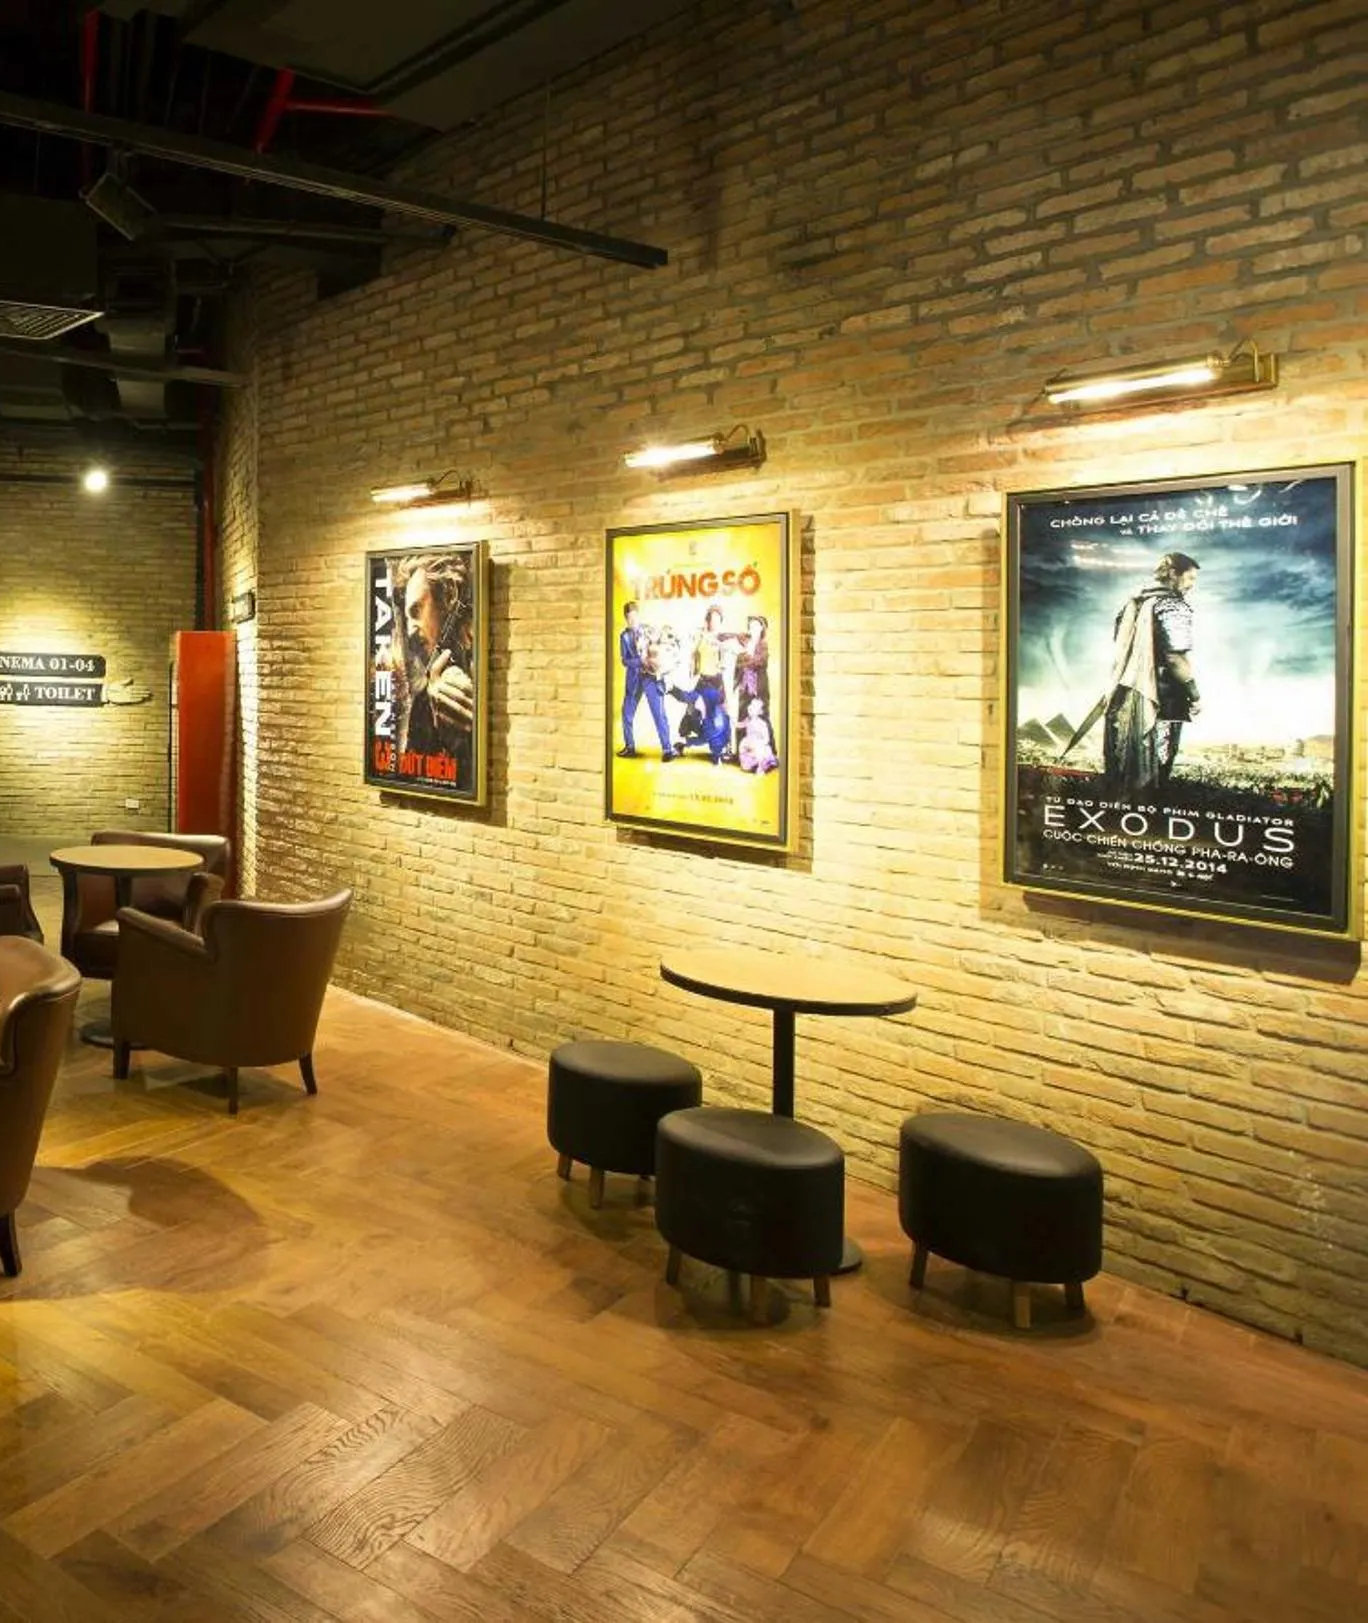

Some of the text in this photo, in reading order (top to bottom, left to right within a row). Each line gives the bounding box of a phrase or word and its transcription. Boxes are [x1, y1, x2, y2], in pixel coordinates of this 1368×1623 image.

[49, 657, 96, 672] 01-04
[375, 577, 393, 735] TAKEN
[34, 686, 96, 700] TOILET
[1163, 807, 1199, 818] PHIM
[1205, 811, 1293, 827] GLADIATOR
[1044, 804, 1294, 853] EXODUS
[1134, 852, 1228, 874] 25.12.2014
